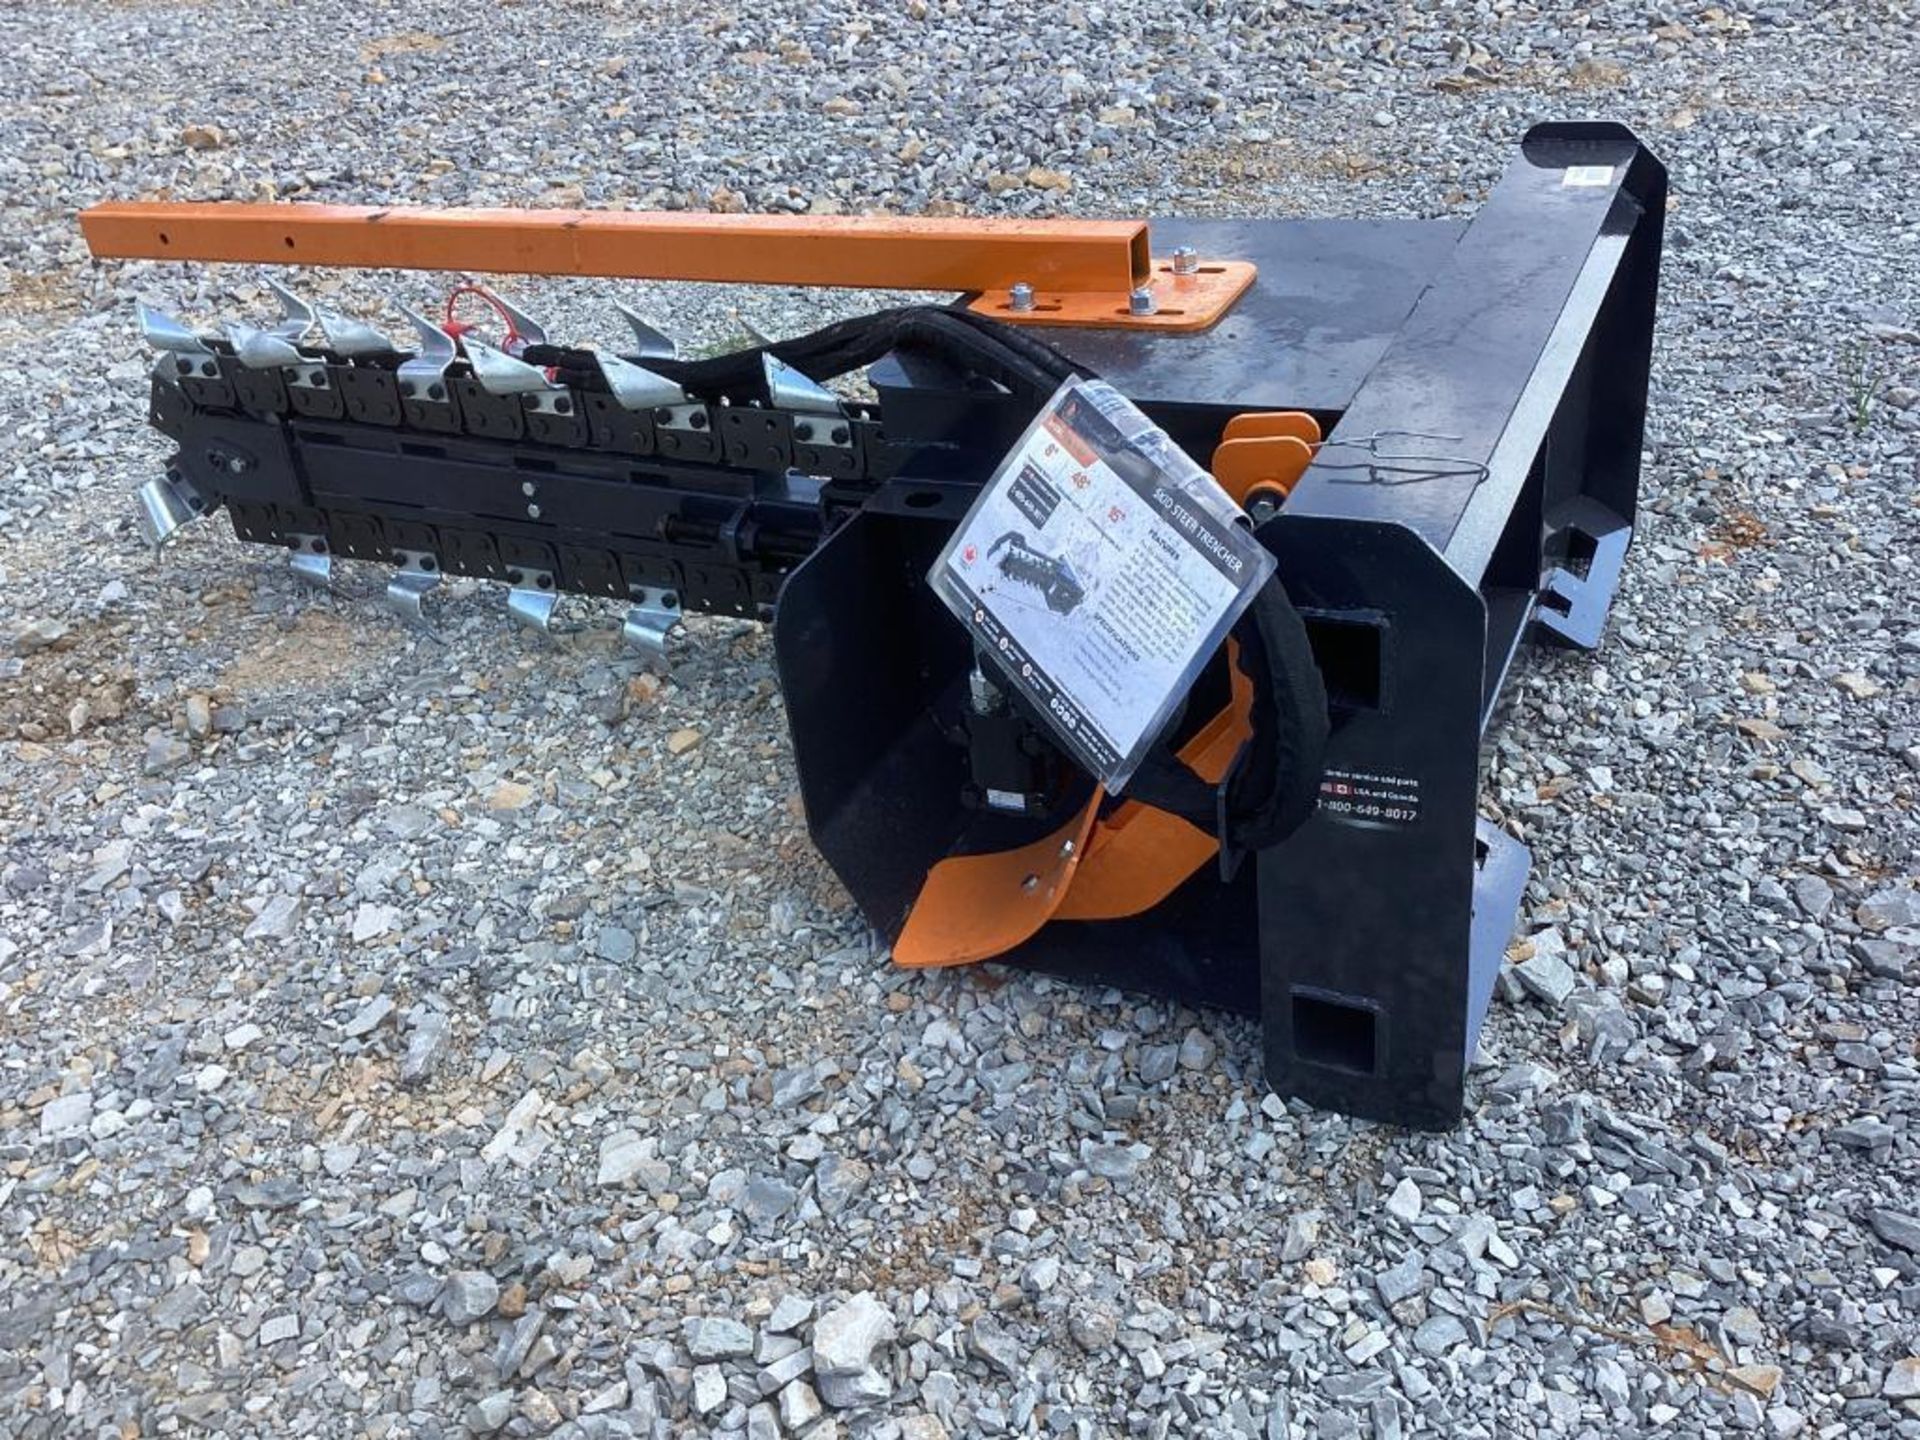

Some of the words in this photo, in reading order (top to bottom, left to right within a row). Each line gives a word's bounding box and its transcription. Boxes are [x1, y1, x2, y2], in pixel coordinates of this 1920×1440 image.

[1153, 488, 1174, 508] SKID
[1171, 504, 1198, 534] STEER
[1196, 525, 1244, 573] TRENCHER
[1353, 788, 1370, 796] USA
[1388, 792, 1419, 802] Canada
